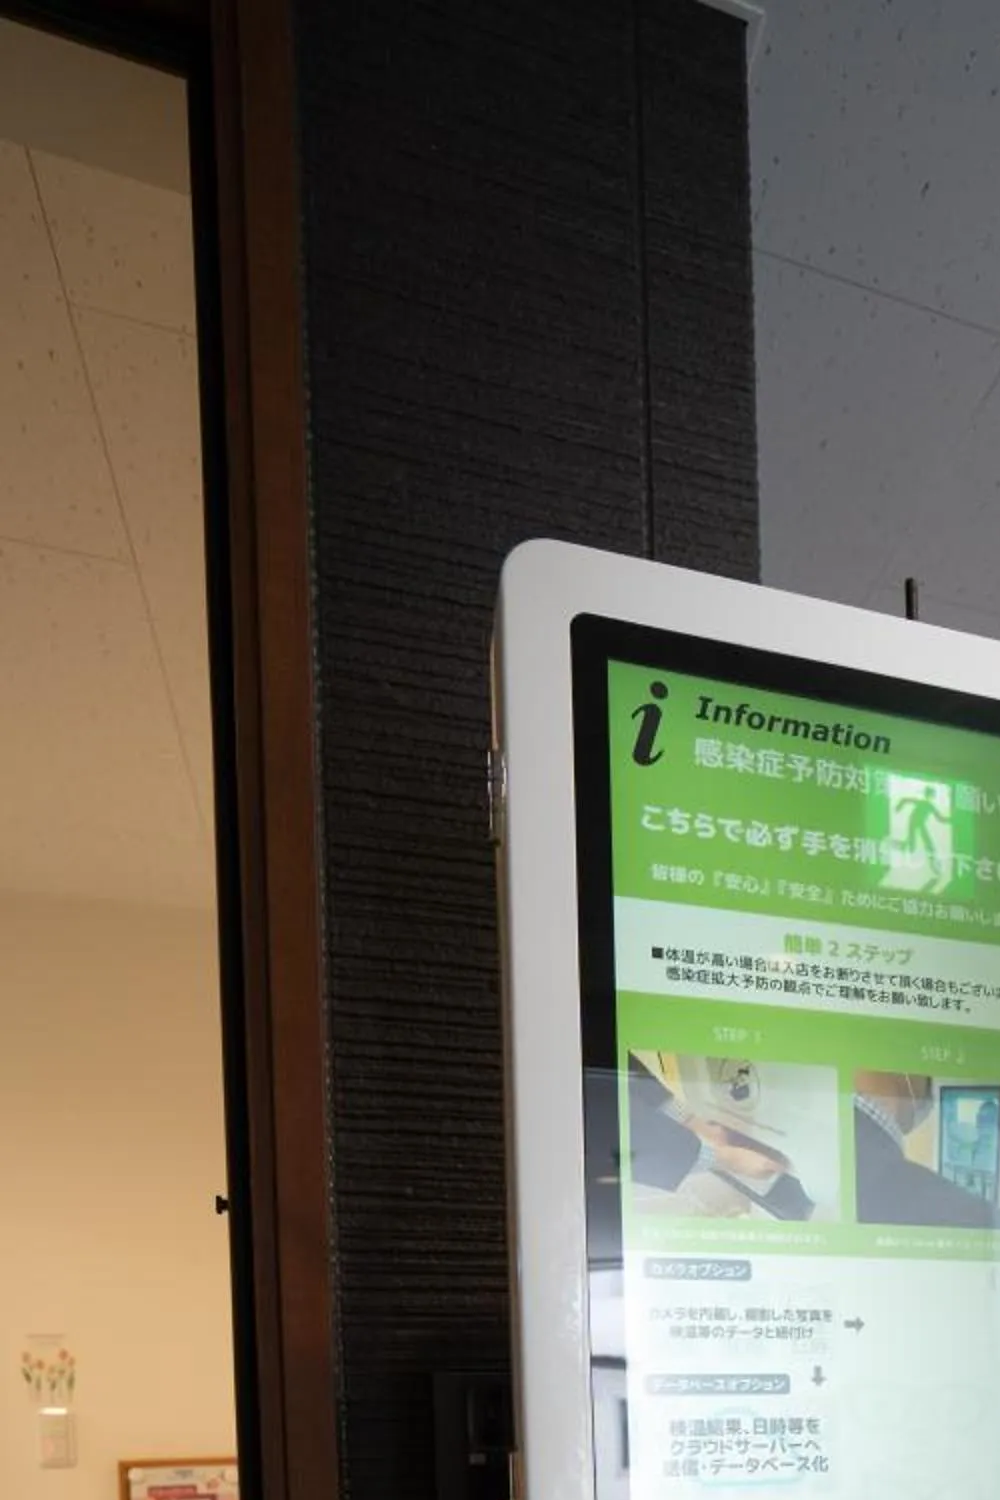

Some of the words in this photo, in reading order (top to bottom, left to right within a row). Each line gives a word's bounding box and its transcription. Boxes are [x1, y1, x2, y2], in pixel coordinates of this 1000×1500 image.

[695, 695, 892, 754] Information
[670, 1438, 822, 1456] クラウドサーバーへ
